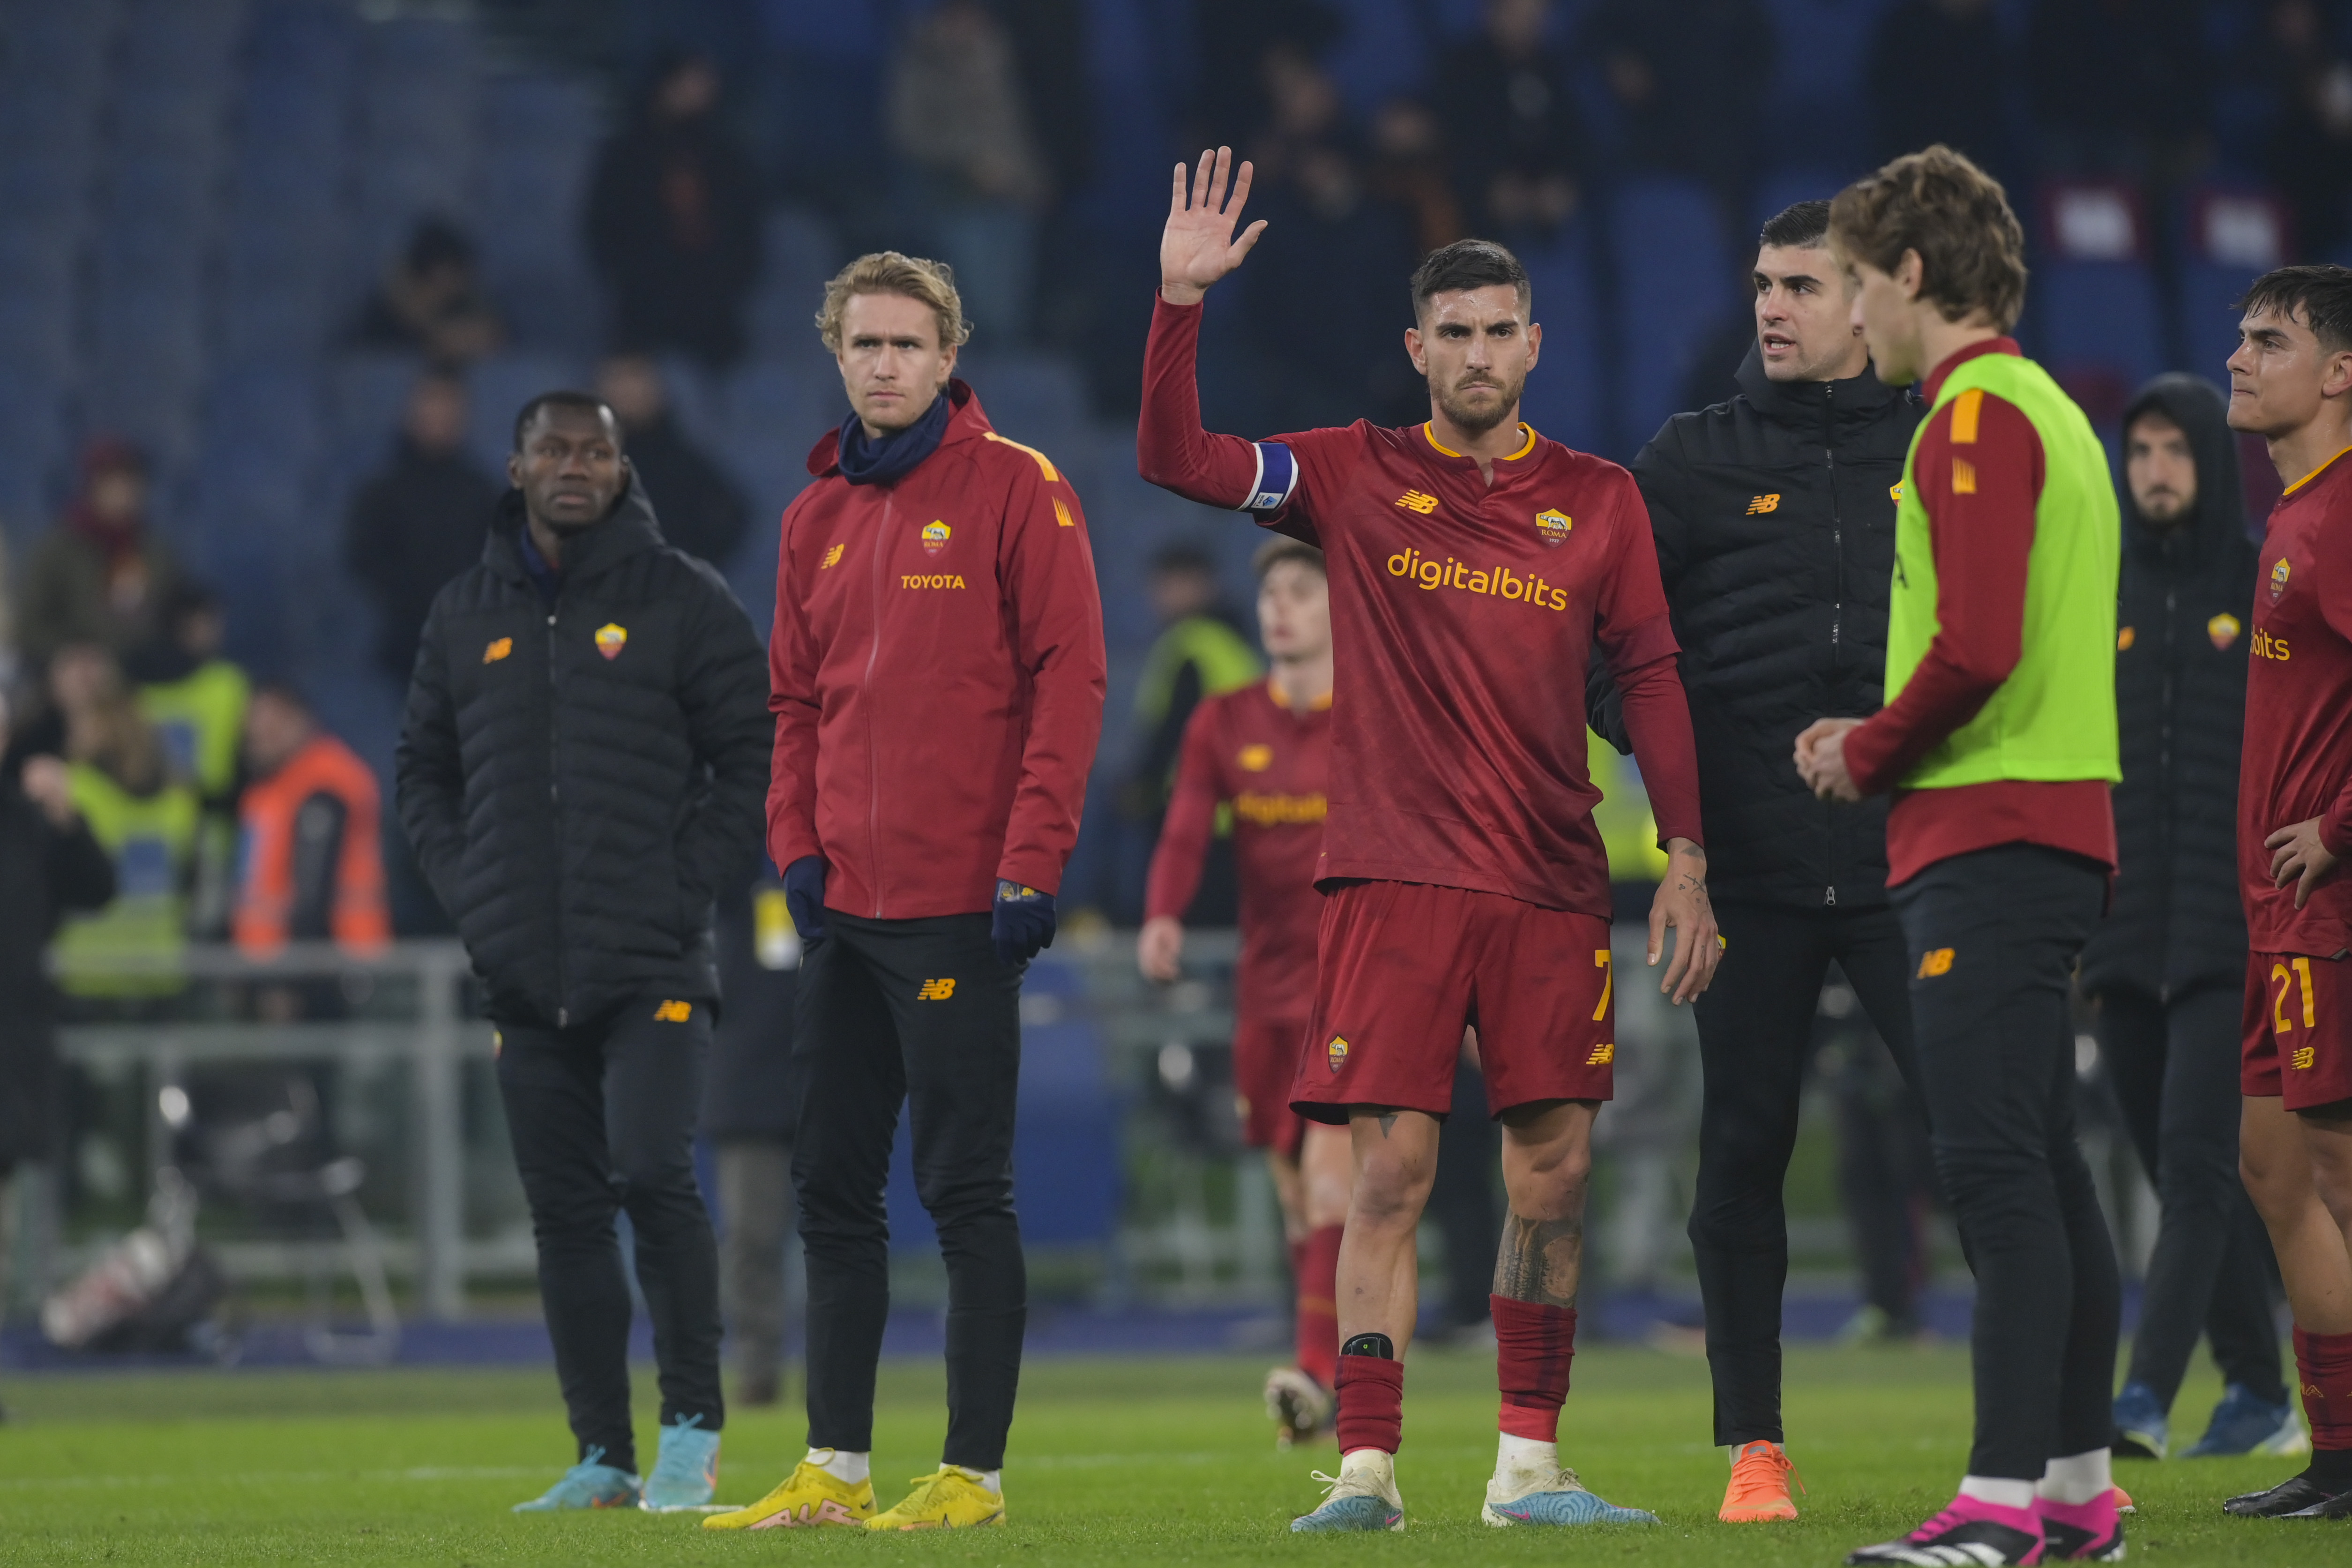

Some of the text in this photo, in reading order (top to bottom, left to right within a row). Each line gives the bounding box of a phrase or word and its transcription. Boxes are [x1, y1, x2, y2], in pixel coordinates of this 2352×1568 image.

[1541, 530, 1567, 538] ROMA
[901, 575, 966, 589] TOYOTA
[1388, 548, 1567, 611] digitalbits
[1592, 949, 1612, 1021] 7
[2271, 956, 2315, 1034] 21
